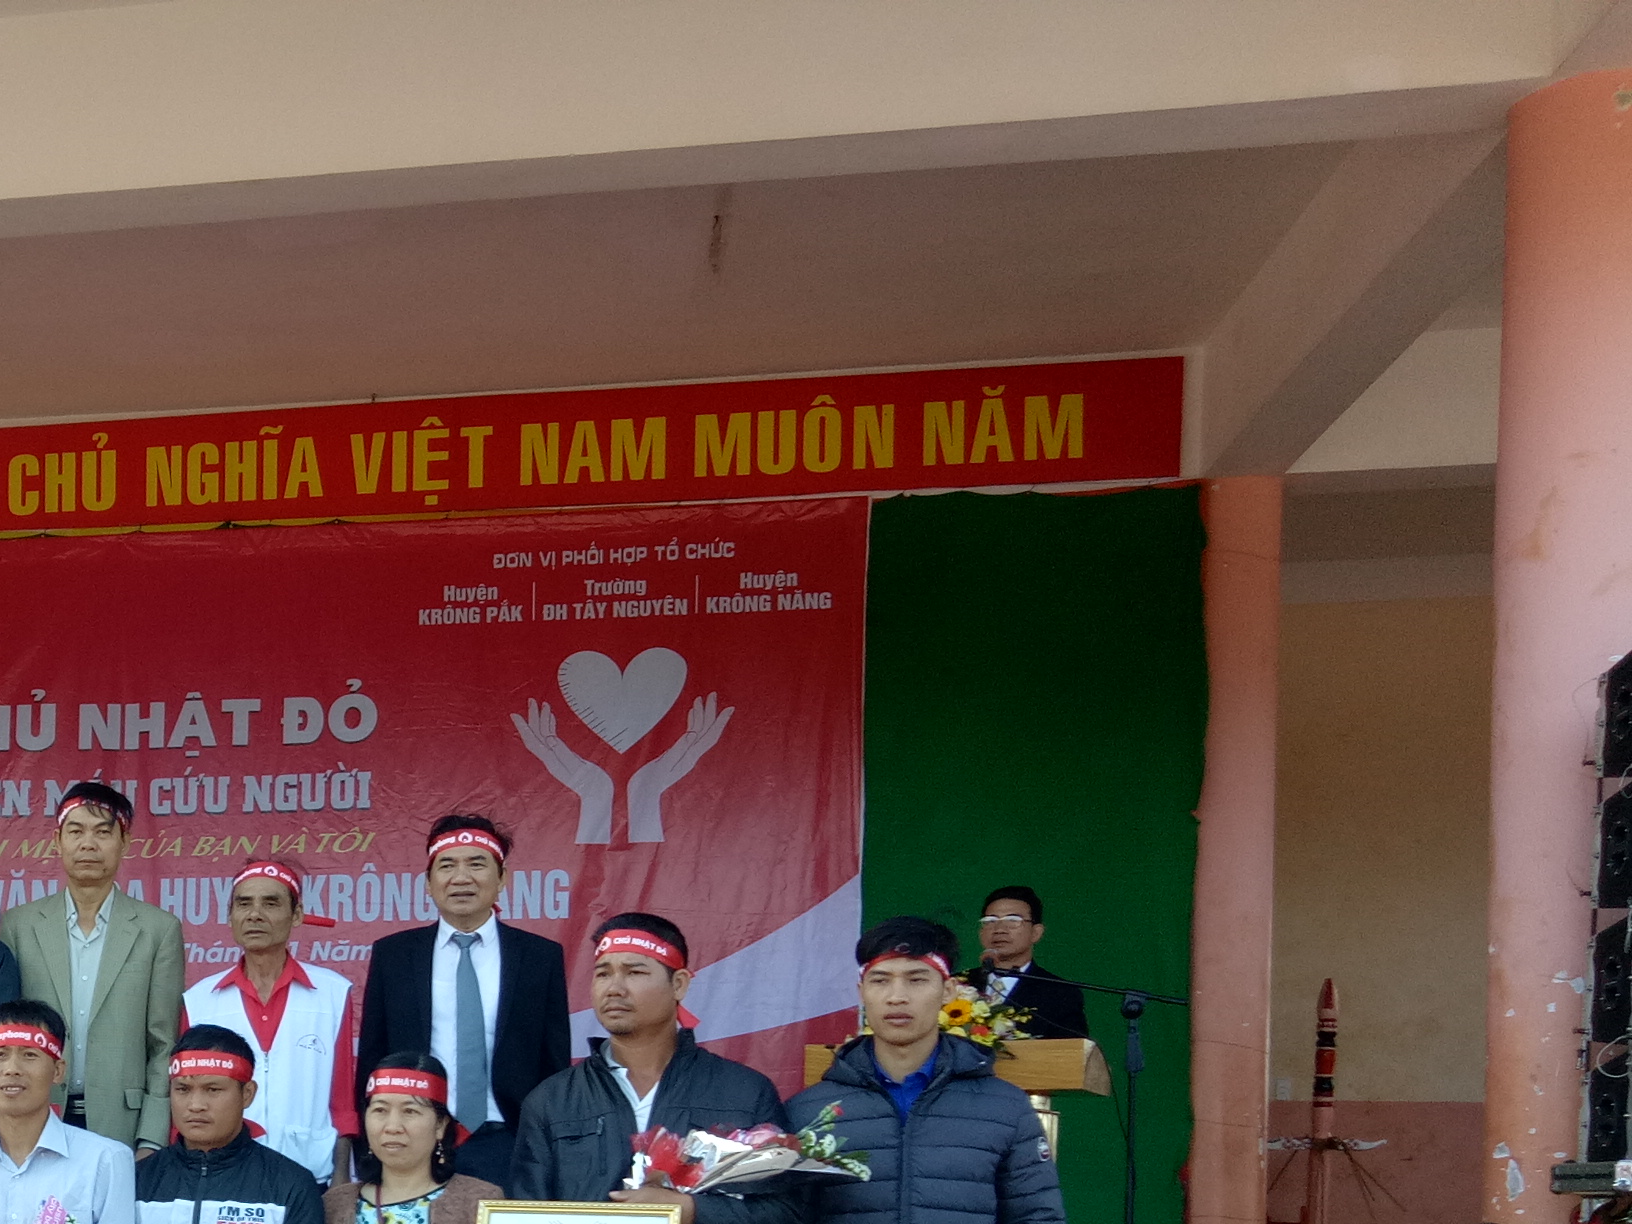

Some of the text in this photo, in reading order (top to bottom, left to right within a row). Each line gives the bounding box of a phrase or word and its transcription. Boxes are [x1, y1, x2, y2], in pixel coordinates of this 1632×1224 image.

[8, 432, 117, 516] CHỦ
[145, 424, 324, 507] NGHĨA
[350, 416, 493, 505] VIỆT
[520, 416, 667, 485] NAM
[693, 394, 895, 478] MUÔN
[922, 384, 1084, 466] NĂM
[492, 536, 736, 570] ĐƠN VỊ PHỐI HỢP TỔ CHỨC
[583, 577, 648, 597] Trường
[739, 569, 799, 591] Huyện
[443, 583, 499, 604] Huyện
[705, 588, 832, 614] KRÔNG NĂNG
[418, 603, 482, 626] KRÔNG
[542, 594, 689, 621] ĐH TÂY NGUYÊN
[77, 690, 262, 757] NHẬT
[280, 678, 379, 746] ĐỎ
[143, 766, 228, 816] CỨU
[242, 760, 372, 809] NGƯỜI
[186, 834, 260, 862] BẠN
[266, 830, 311, 856] VÀ
[313, 826, 375, 854] TÔI
[160, 873, 234, 926] HUY
[305, 862, 430, 921] KRÔNG
[184, 940, 244, 964] Thán
[613, 936, 668, 956] CHỦ NHẬT ĐỎ
[180, 1058, 235, 1071] CHỦ NHẬT ĐỎ
[375, 1076, 429, 1090] CHỦ NHẬT ĐỎ
[218, 1206, 265, 1218] I'M SO
